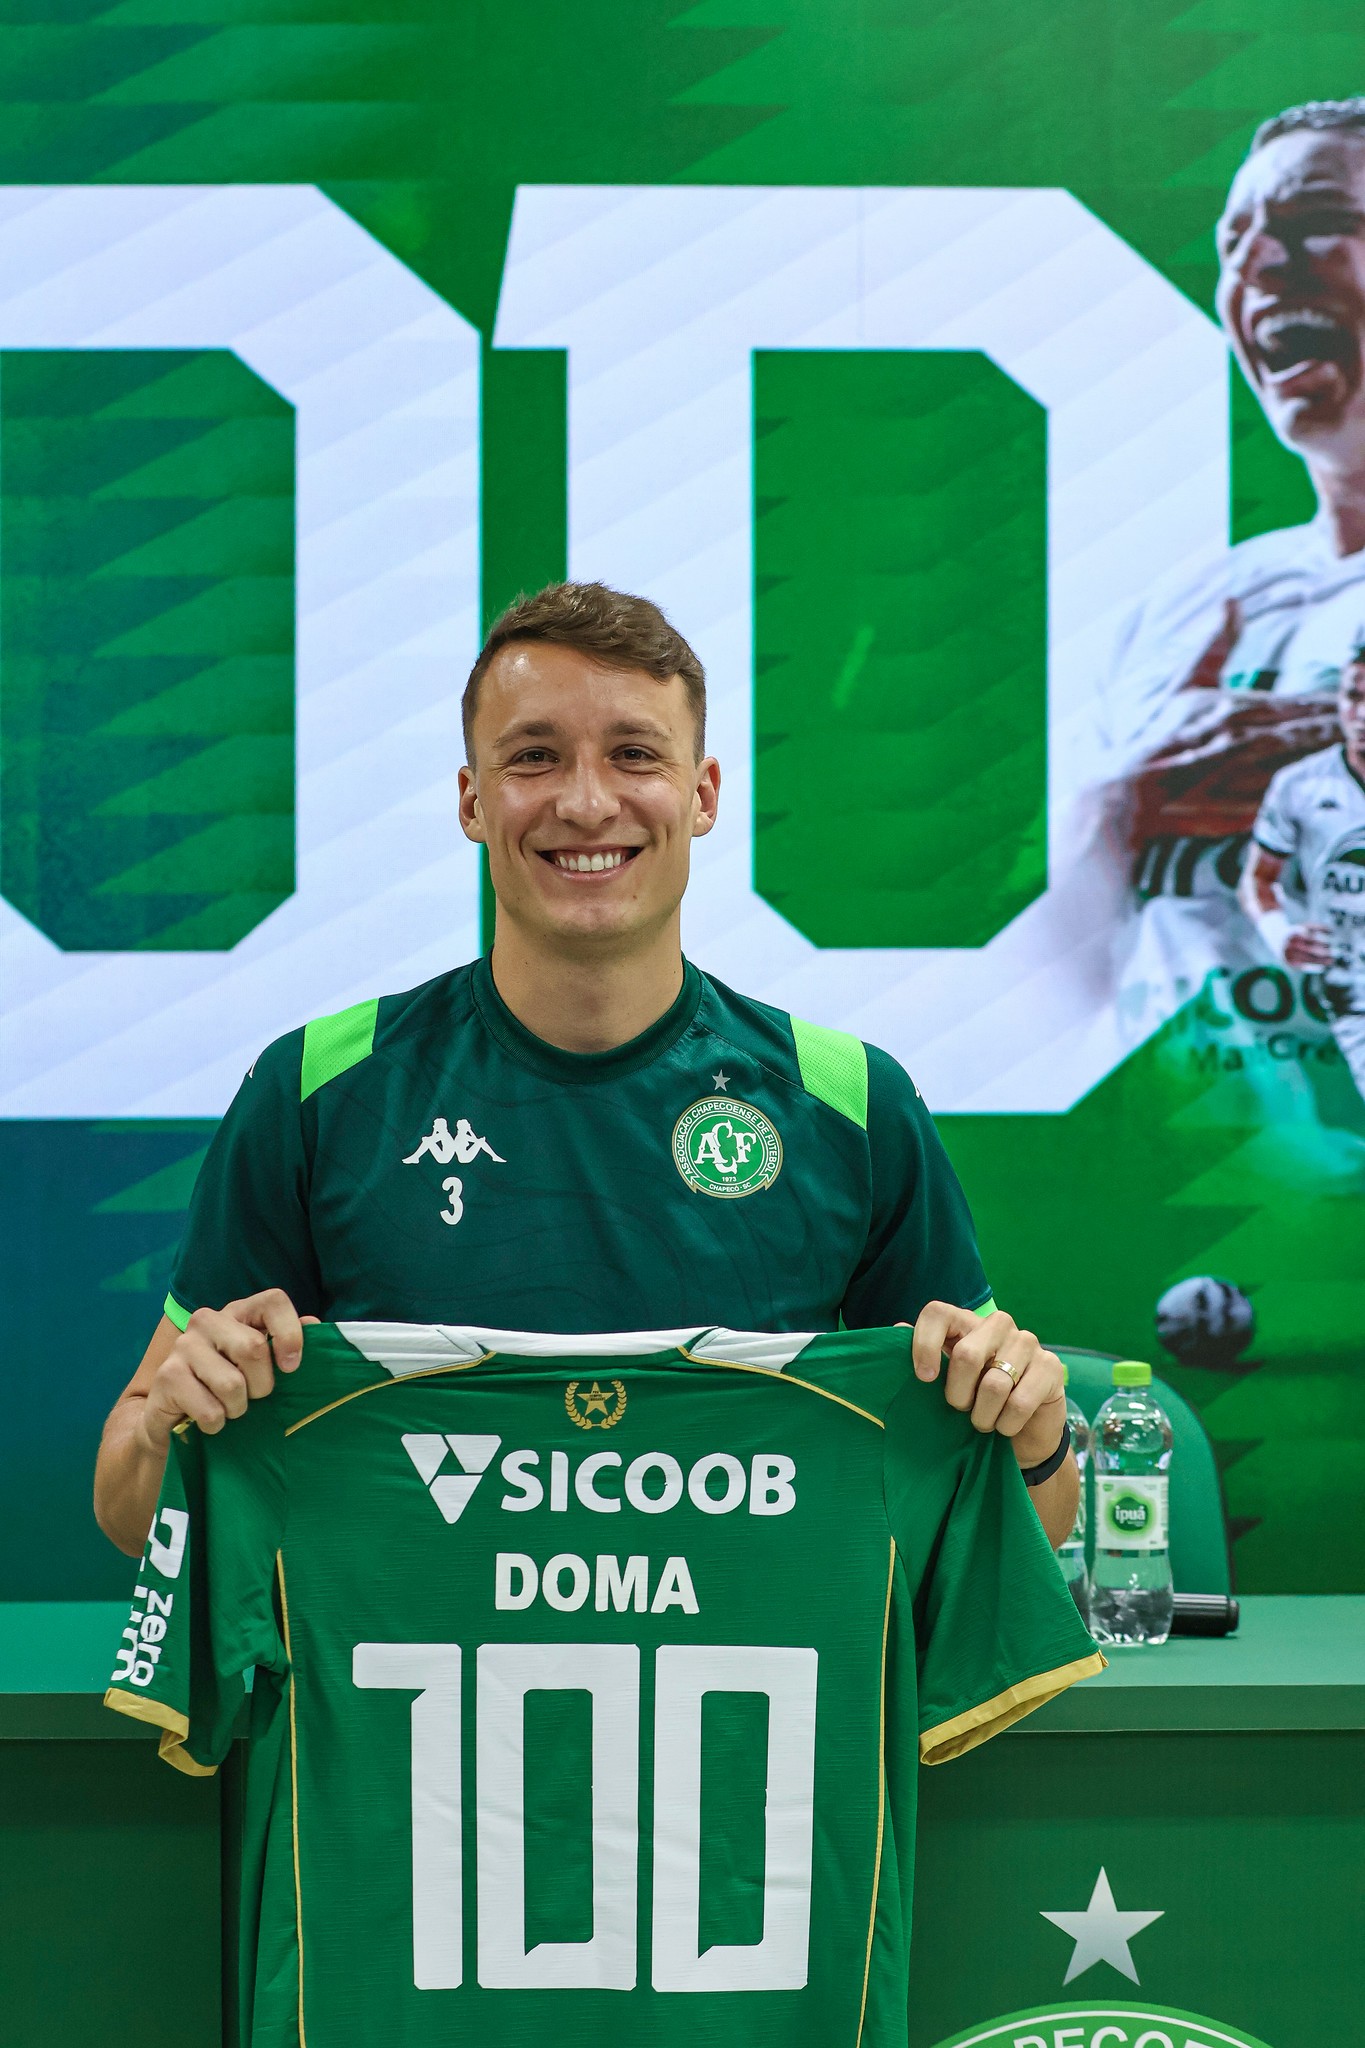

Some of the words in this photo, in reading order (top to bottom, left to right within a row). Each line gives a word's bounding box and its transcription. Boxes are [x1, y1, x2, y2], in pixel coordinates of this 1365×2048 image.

[691, 1102, 759, 1122] CHAPECOENSE
[756, 1121, 769, 1135] DE
[765, 1134, 777, 1173] FUTEBOL
[694, 1120, 757, 1175] ACF
[440, 1176, 464, 1225] 3
[500, 1449, 797, 1516] SICOOB
[495, 1552, 700, 1615] DOMA
[129, 1589, 174, 1687] zero
[352, 1642, 819, 1993] 100
